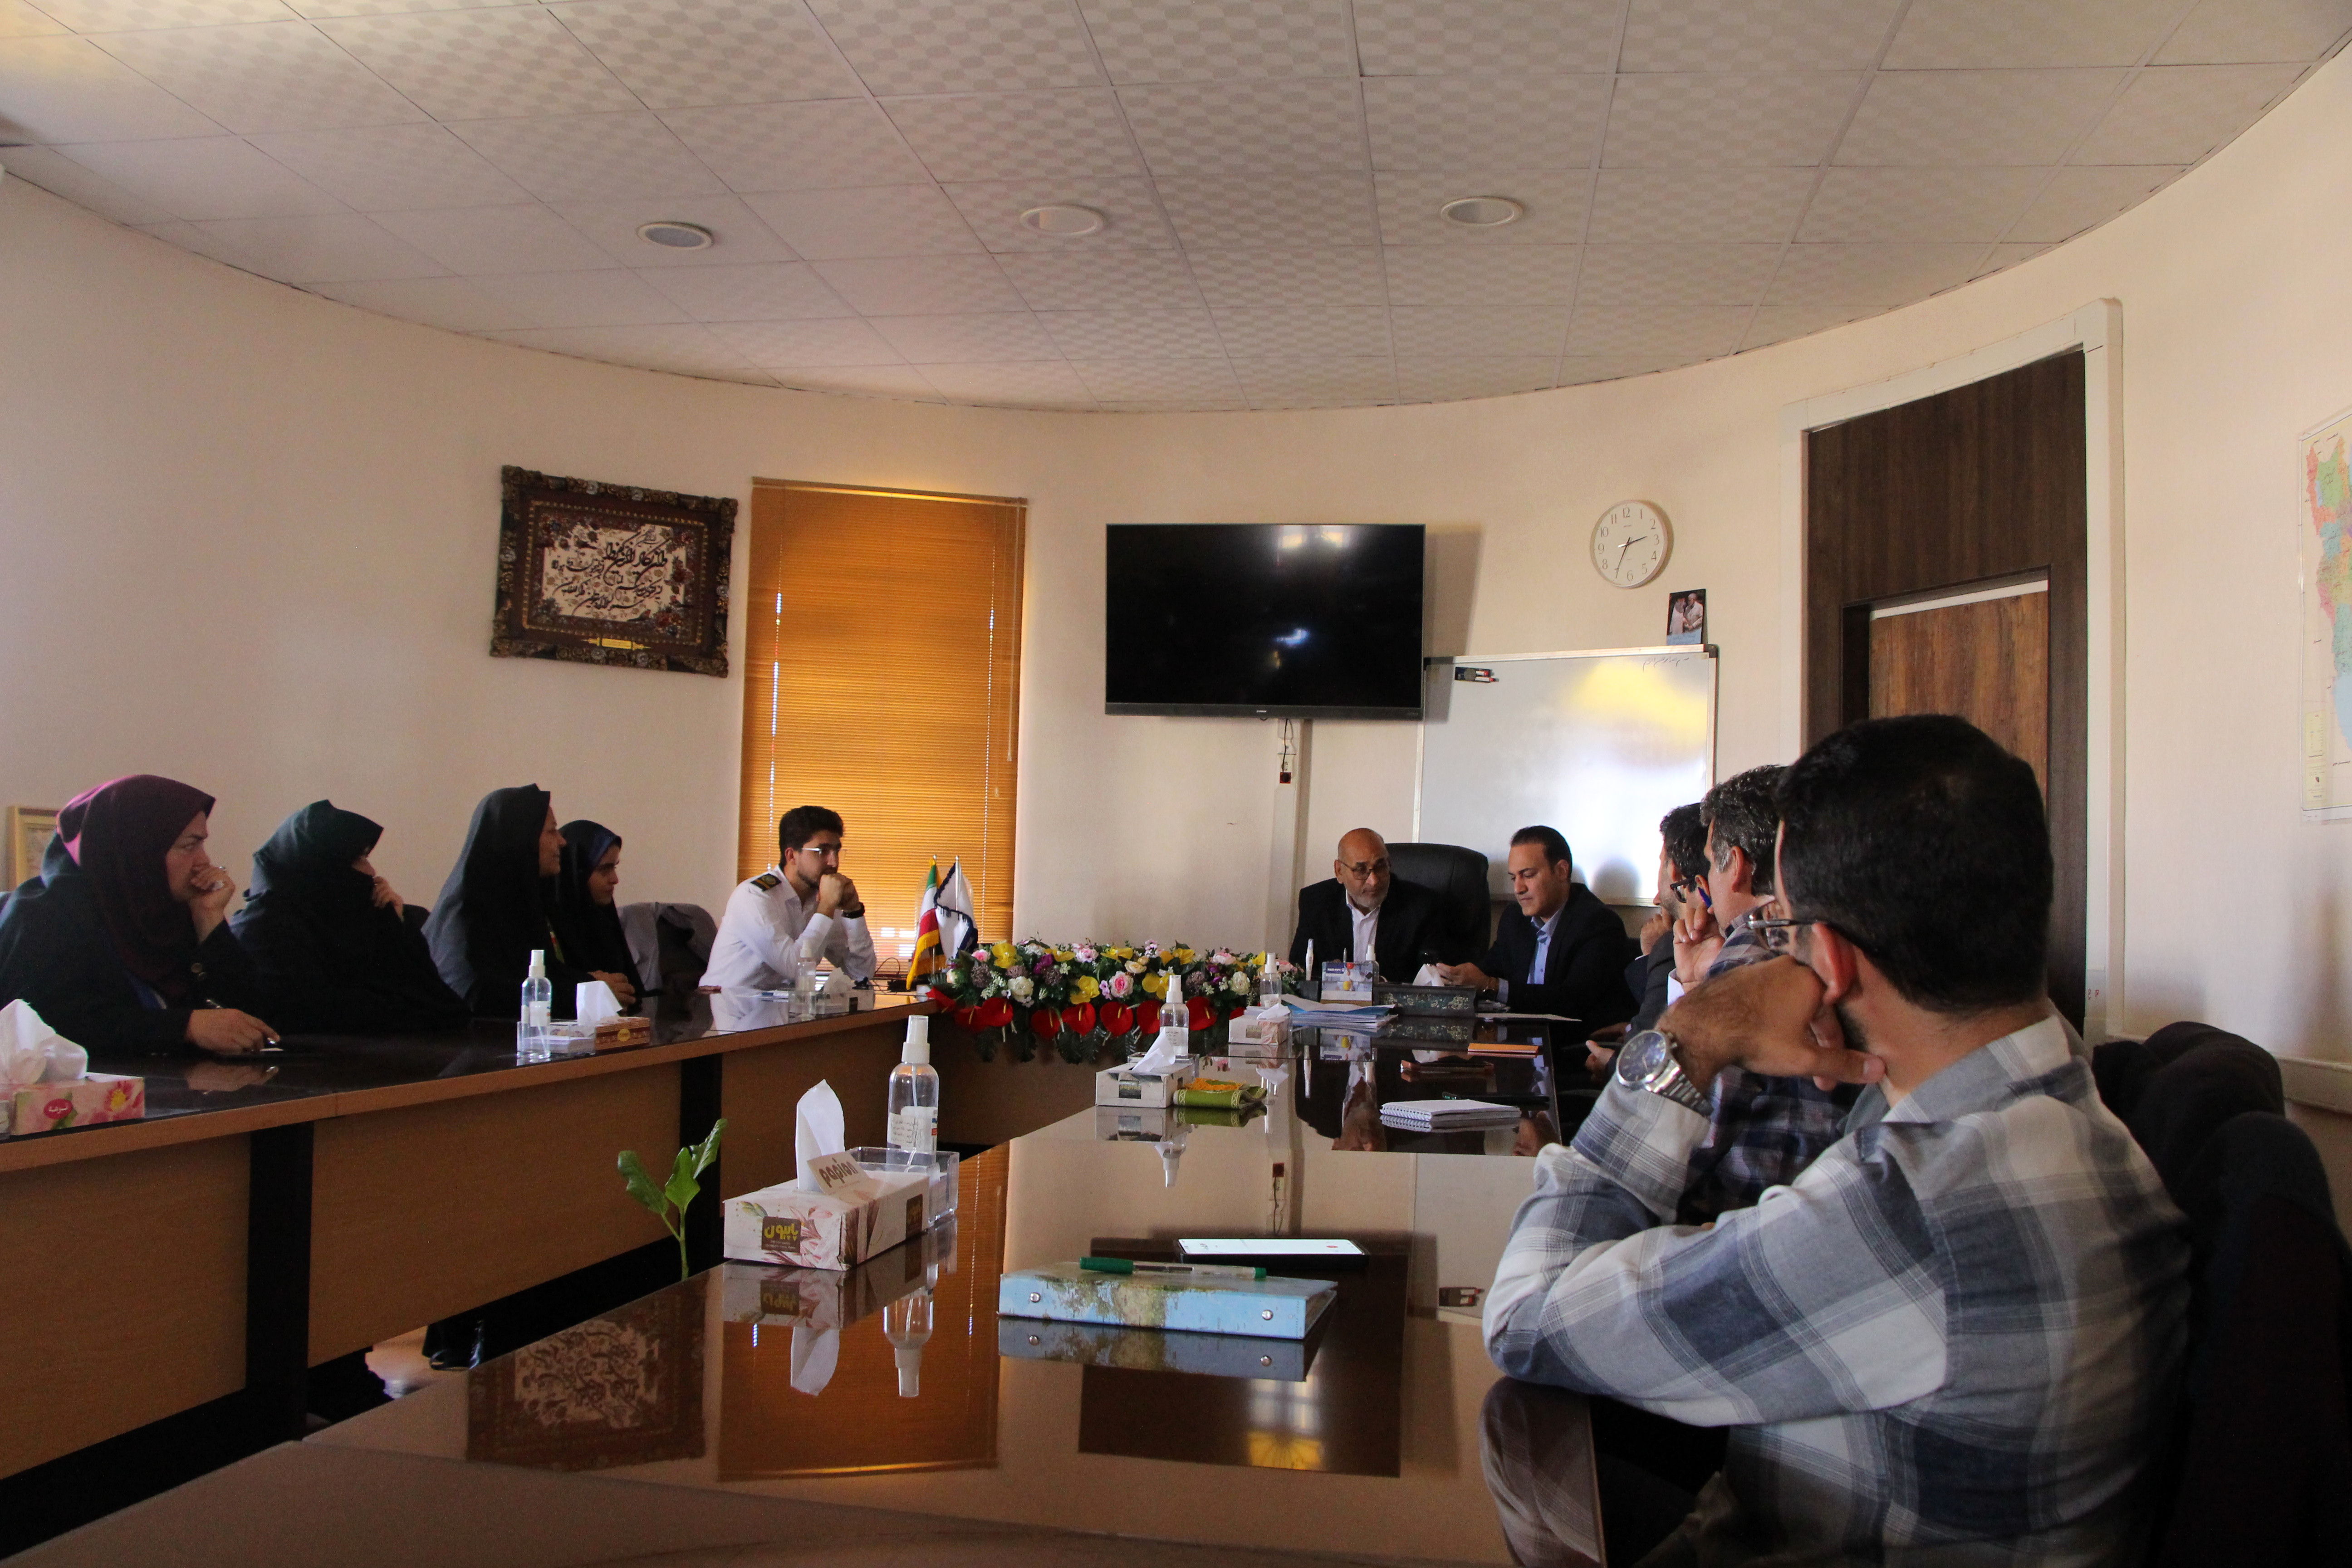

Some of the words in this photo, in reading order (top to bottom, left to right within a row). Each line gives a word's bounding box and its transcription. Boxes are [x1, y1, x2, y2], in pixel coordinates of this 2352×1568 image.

[1623, 507, 1631, 518] 12
[1611, 514, 1617, 524] 11
[1650, 519, 1656, 529] 2
[1601, 527, 1608, 538] 10
[1653, 534, 1659, 545] 3
[1598, 543, 1604, 554] 9
[1651, 551, 1657, 561] 4
[1602, 559, 1608, 569] 8
[1642, 563, 1647, 574] 5
[1614, 568, 1619, 578] 7
[1627, 570, 1633, 581] 6
[819, 1157, 858, 1188] papion
[764, 1223, 799, 1241] پاپیون
